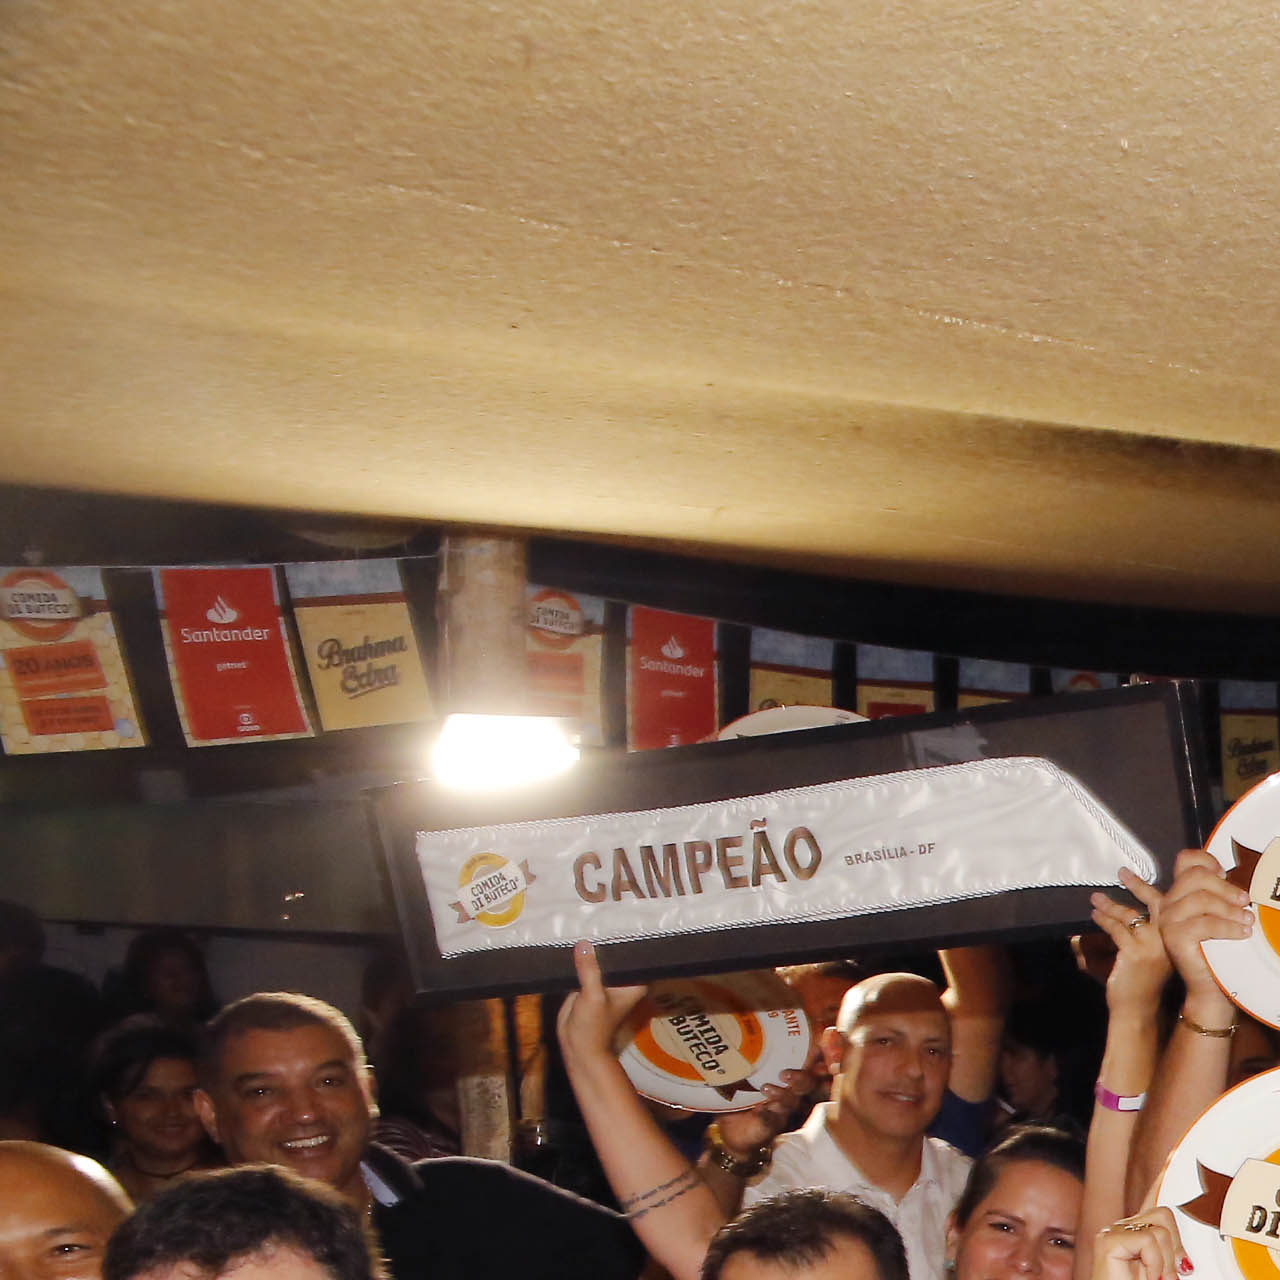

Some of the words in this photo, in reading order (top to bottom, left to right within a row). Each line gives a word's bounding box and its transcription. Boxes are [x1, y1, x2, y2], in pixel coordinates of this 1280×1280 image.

[180, 627, 271, 644] Santander
[640, 656, 704, 677] Santander
[573, 817, 822, 904] CAMPEÃO
[844, 845, 907, 866] BRASÍLIA
[918, 842, 936, 855] DF
[471, 873, 506, 897] COMIDA
